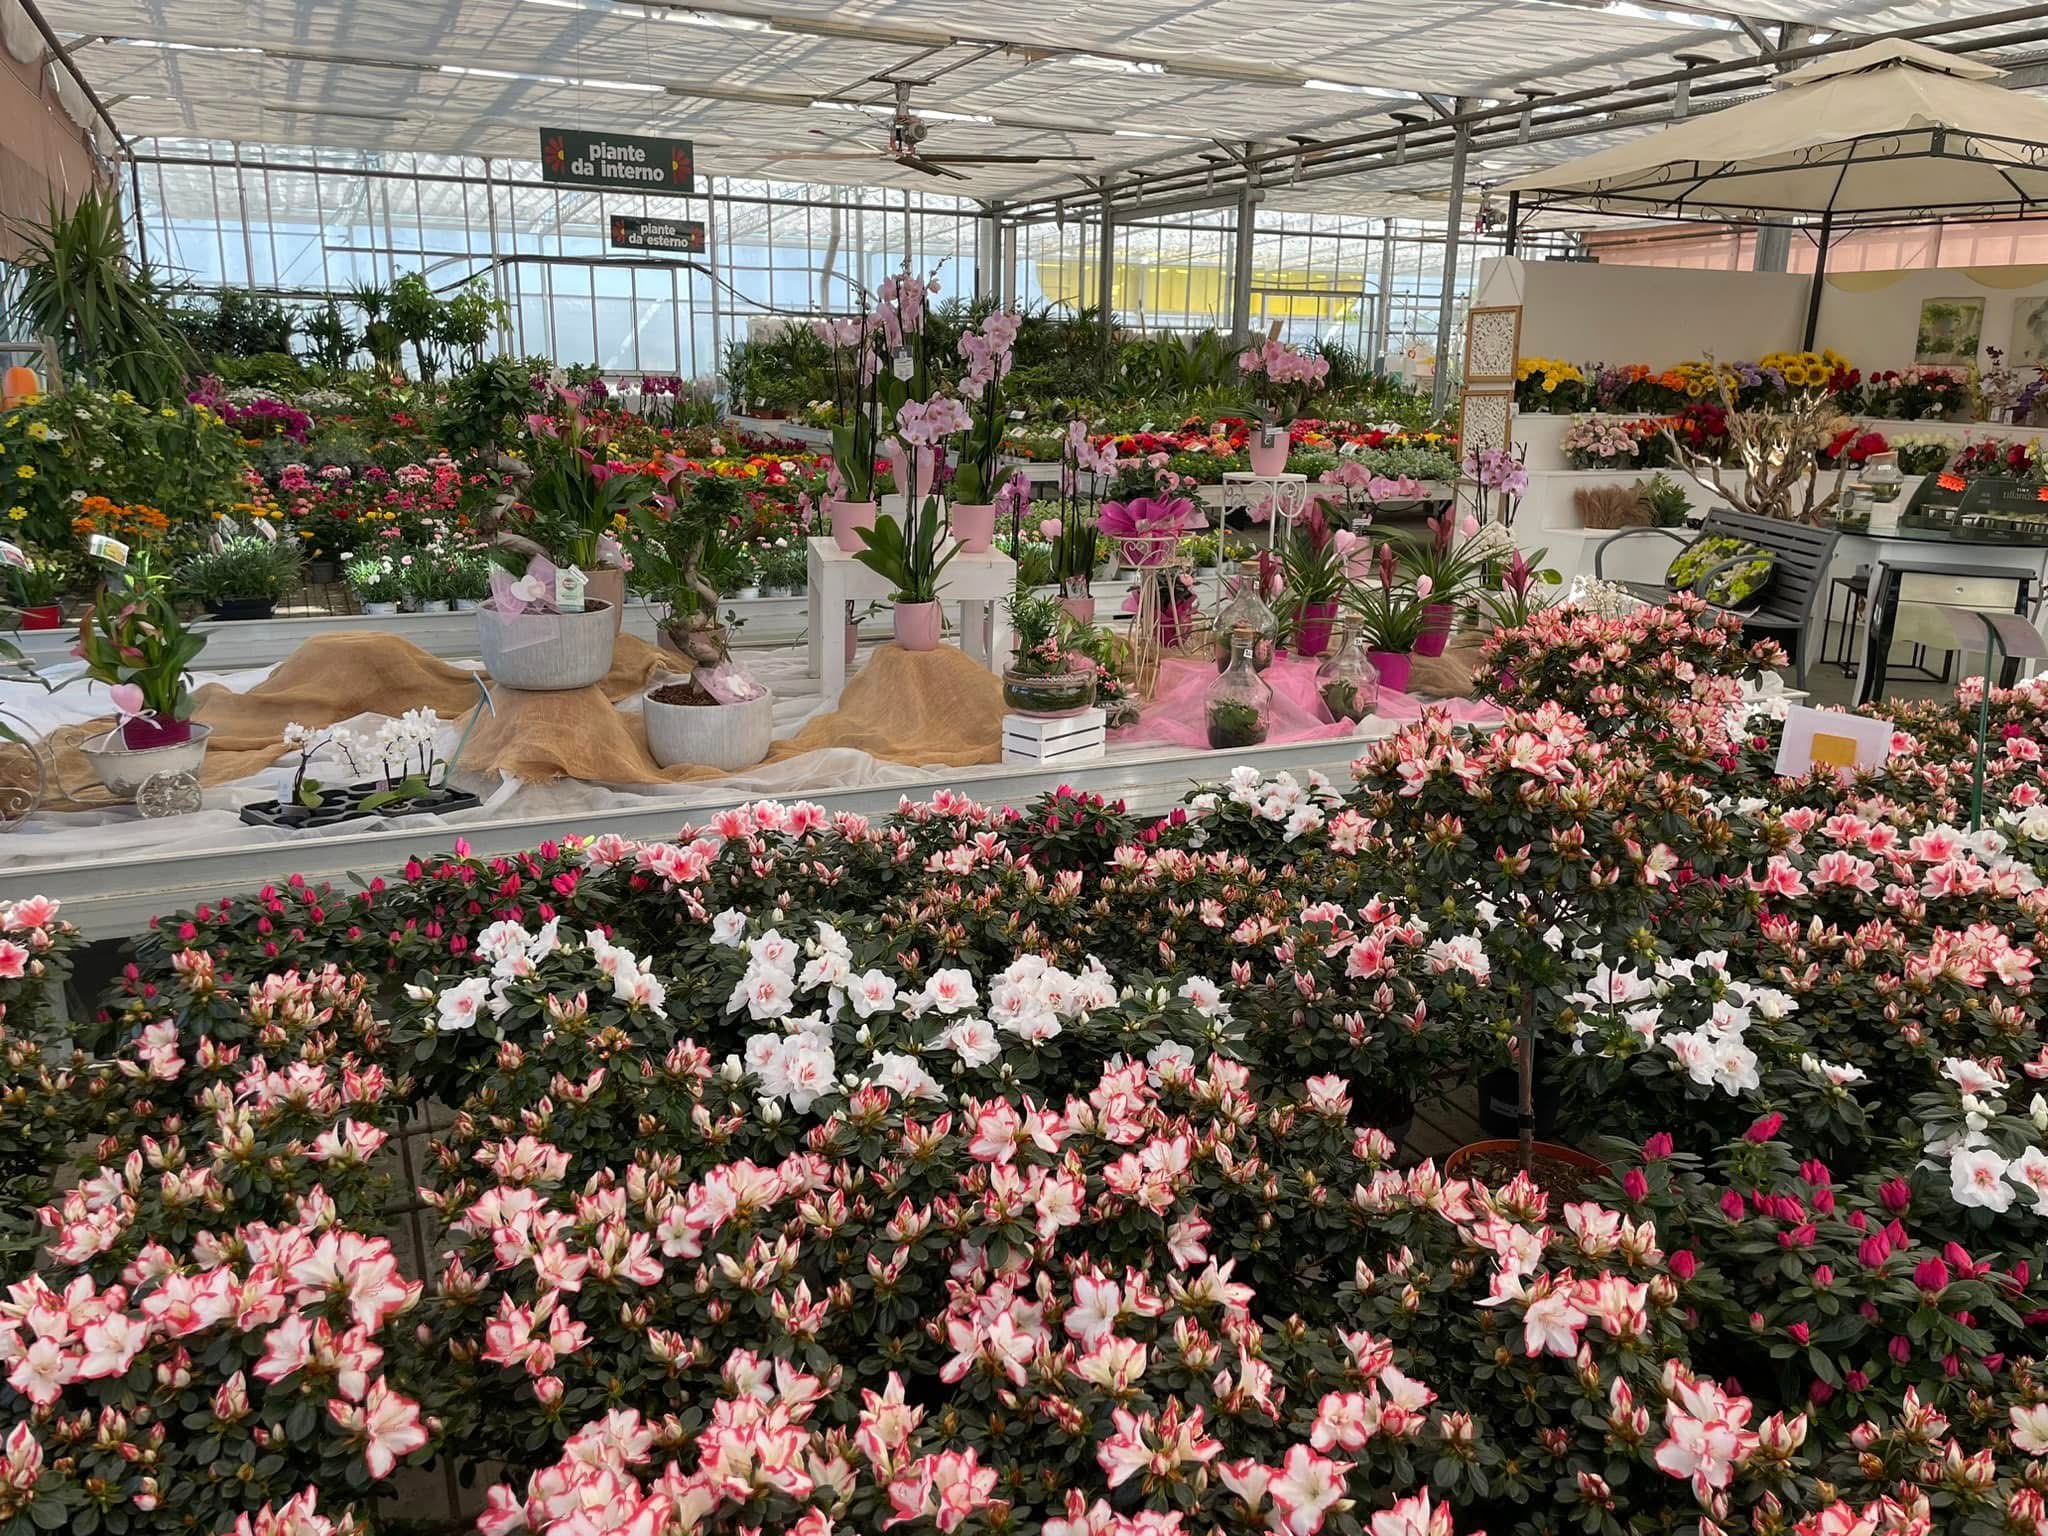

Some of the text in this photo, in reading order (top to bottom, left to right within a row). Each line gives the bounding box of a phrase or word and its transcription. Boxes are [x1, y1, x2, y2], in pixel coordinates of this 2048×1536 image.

[589, 142, 645, 161] piante
[571, 158, 664, 181] da interno
[640, 223, 676, 236] piante
[628, 233, 688, 247] da esterno
